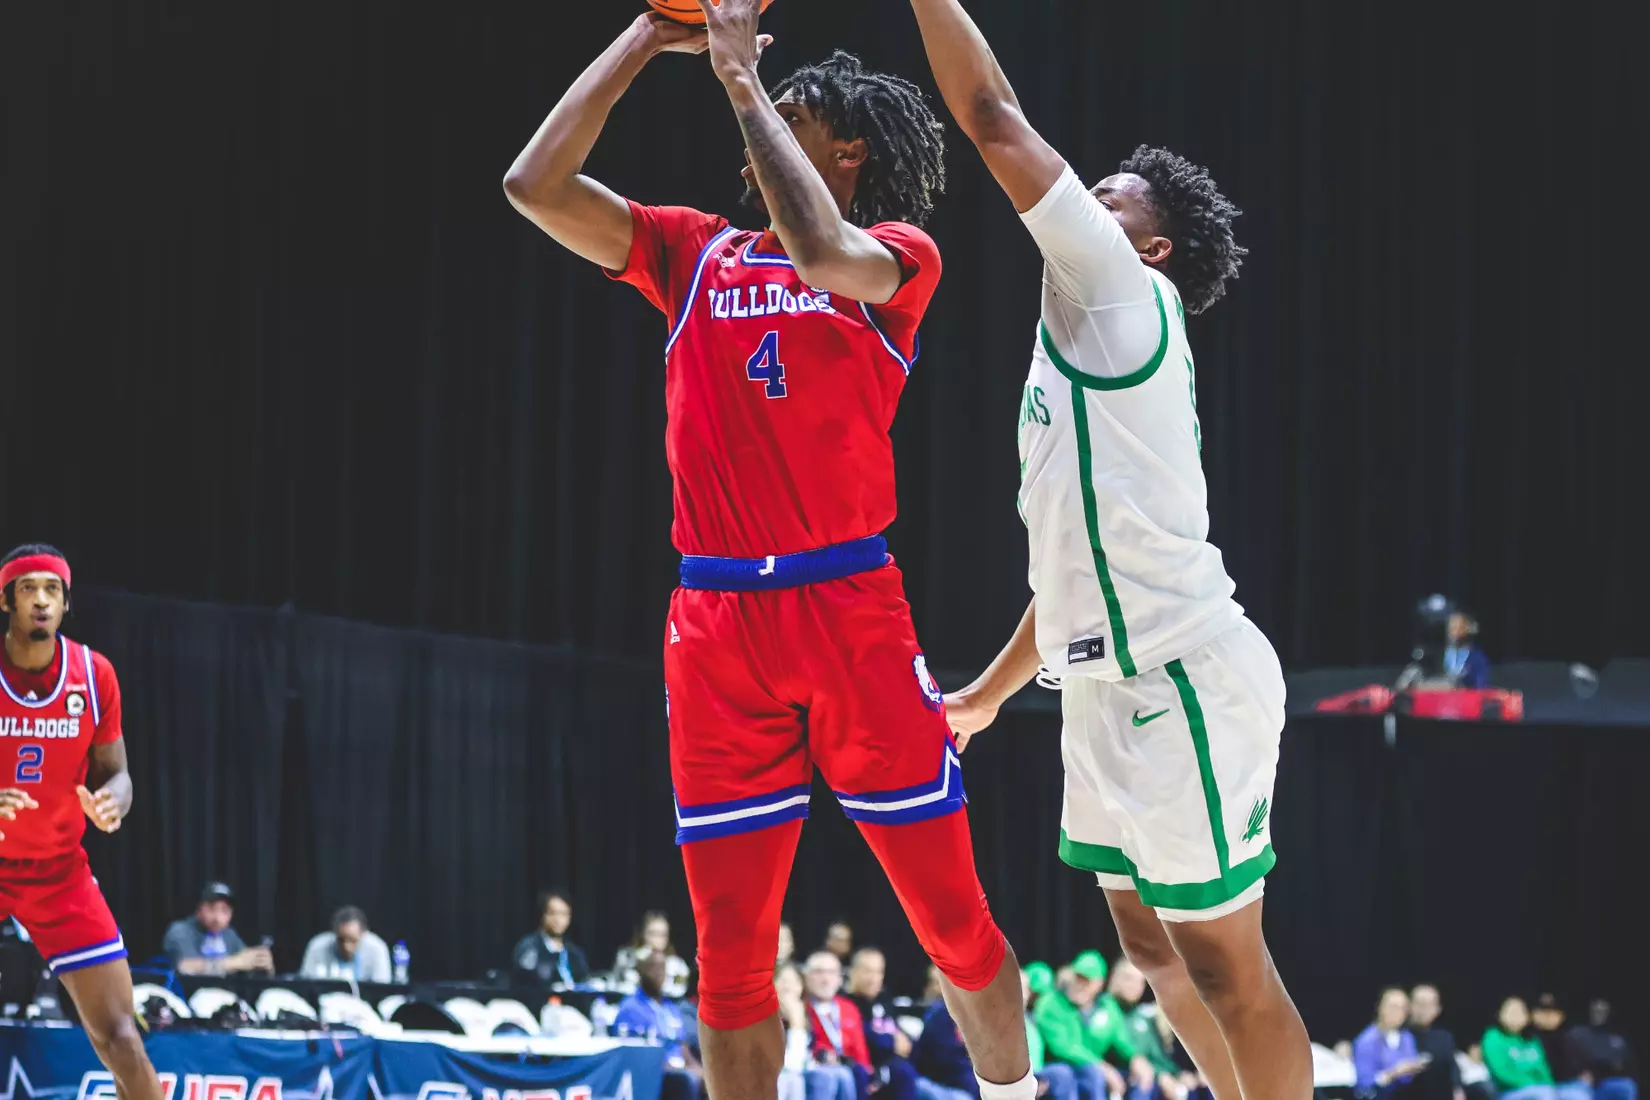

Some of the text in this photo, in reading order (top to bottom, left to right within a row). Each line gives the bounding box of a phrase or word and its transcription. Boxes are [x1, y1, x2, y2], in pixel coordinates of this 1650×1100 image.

[746, 331, 786, 398] 4
[1091, 644, 1099, 653] M
[0, 717, 80, 738] ULLDOGS
[15, 745, 44, 783] 2
